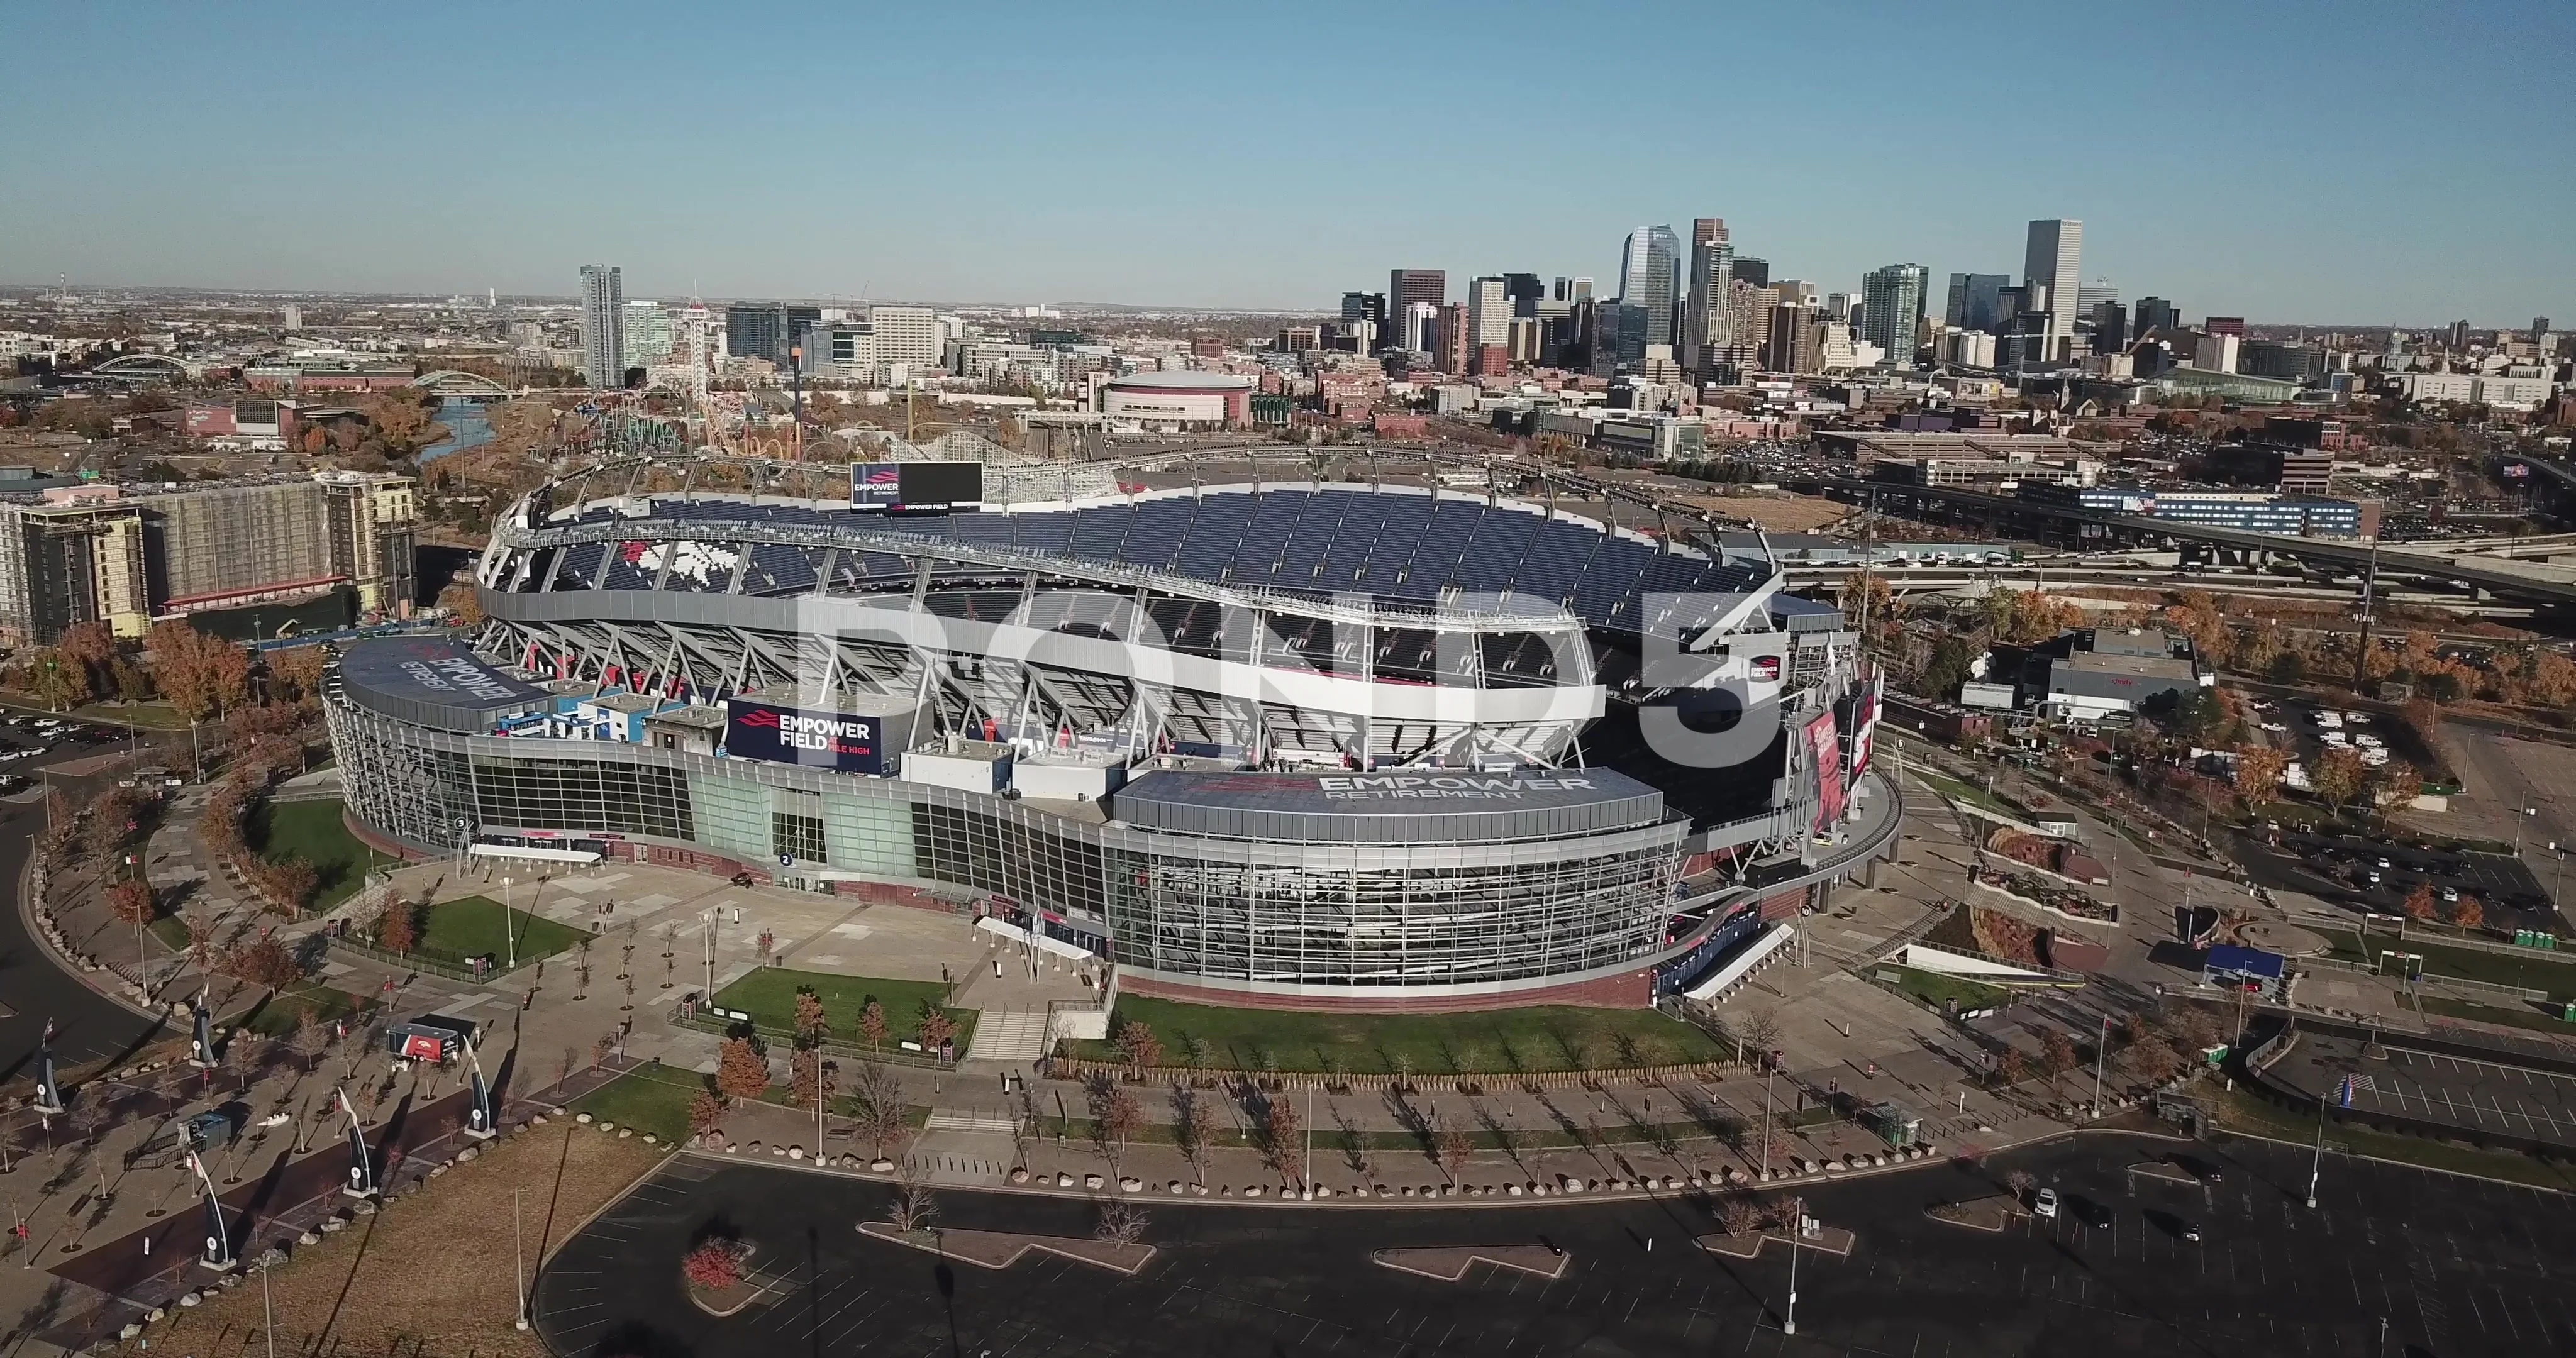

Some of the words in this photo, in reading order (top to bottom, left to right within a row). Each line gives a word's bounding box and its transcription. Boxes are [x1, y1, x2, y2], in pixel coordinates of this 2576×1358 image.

[854, 483, 899, 492] EMPOWER
[428, 657, 518, 700] EMPOWER
[779, 714, 870, 740] EMPOWER
[780, 731, 828, 751] FIELD
[828, 744, 847, 753] MILE
[848, 746, 870, 755] HIGH
[1319, 776, 1598, 791] EMPOWER
[1324, 789, 1526, 800] RETIREMENT
[782, 855, 789, 864] 2
[1801, 908, 1809, 917] 10
